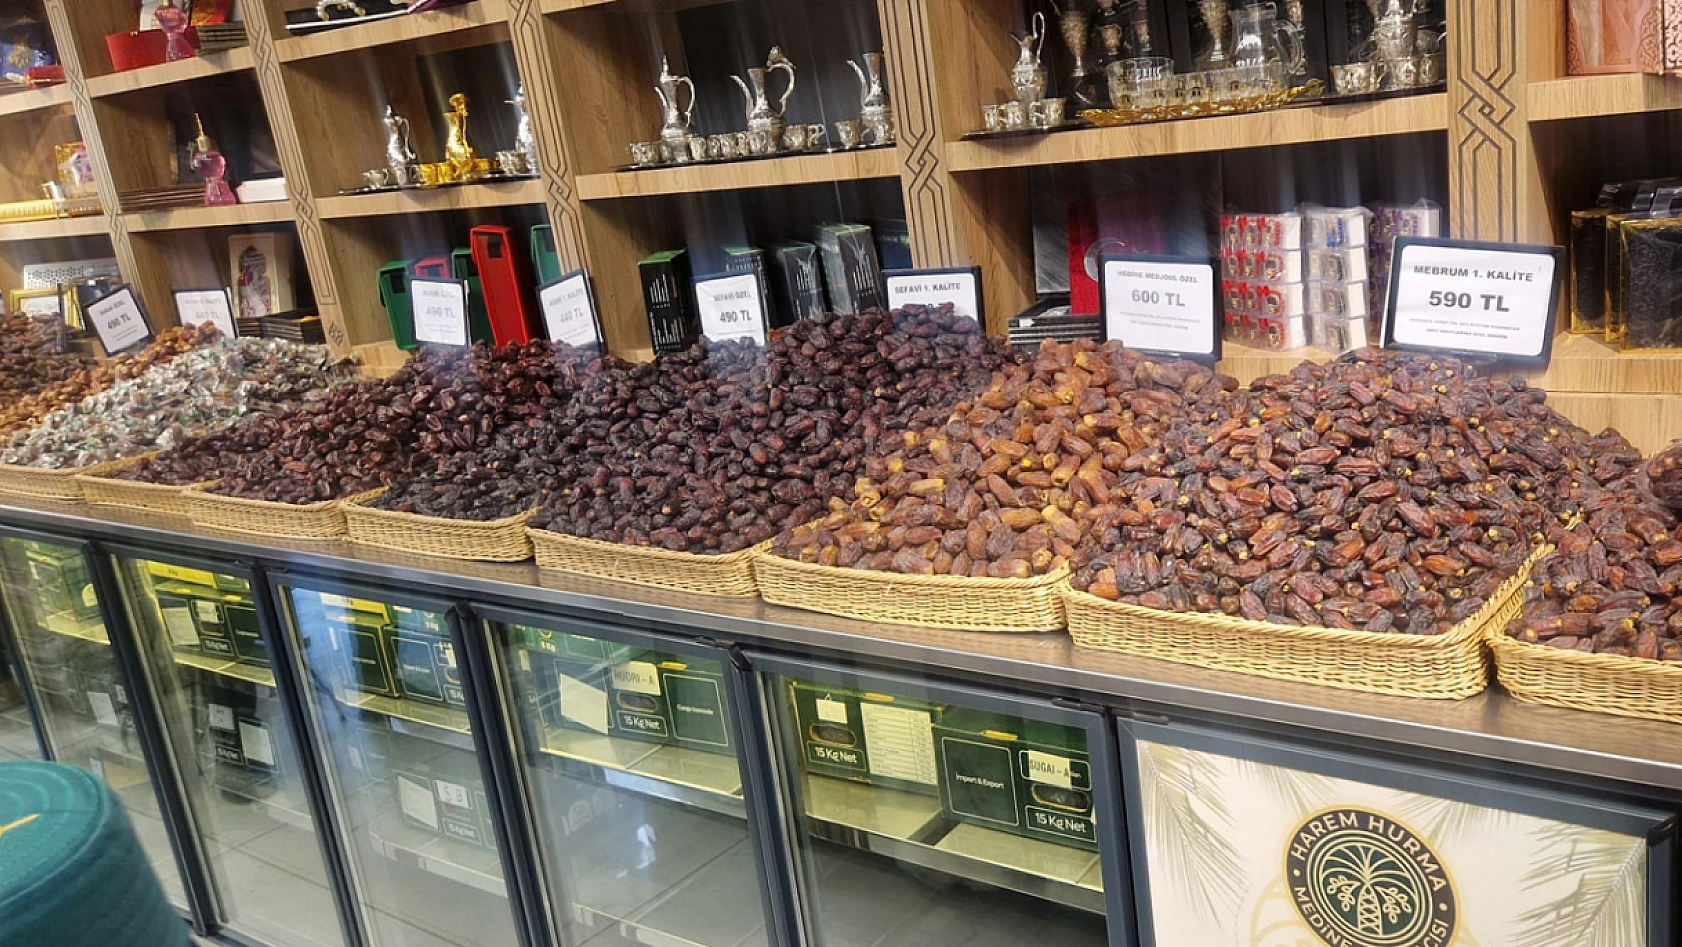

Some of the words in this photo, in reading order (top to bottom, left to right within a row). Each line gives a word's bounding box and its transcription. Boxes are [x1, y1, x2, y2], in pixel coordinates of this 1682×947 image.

[1144, 271, 1178, 282] MEDJOUL
[1179, 274, 1198, 284] ÖZEL
[1413, 265, 1469, 277] MEBRUM
[1473, 270, 1483, 279] 1.
[1486, 269, 1534, 282] KALİTE
[932, 281, 961, 292] KALİTE
[1131, 289, 1160, 305] 600
[1165, 291, 1186, 307] TL
[1428, 290, 1472, 309] 590
[1480, 293, 1510, 313] TL
[209, 311, 221, 320] TL
[426, 305, 442, 317] 490
[444, 307, 457, 318] TL
[573, 307, 583, 318] TL
[719, 310, 738, 324] 490
[739, 309, 753, 322] TL
[107, 317, 121, 330] 490
[119, 313, 131, 323] TL
[614, 671, 640, 683] HUDRI
[648, 674, 655, 686] A
[624, 715, 633, 725] 15
[633, 716, 645, 730] Kg
[645, 718, 660, 730] Net
[814, 746, 825, 758] 15
[826, 748, 839, 763] Kg
[840, 750, 857, 764] Net
[1029, 759, 1056, 774] SUGAI
[955, 771, 978, 784] Import
[982, 779, 1005, 790] Export
[1035, 812, 1047, 824] 15
[1049, 815, 1064, 831] Kg
[1065, 818, 1087, 833] Net
[1290, 812, 1359, 861] HAREM
[1368, 815, 1447, 892] HURMA
